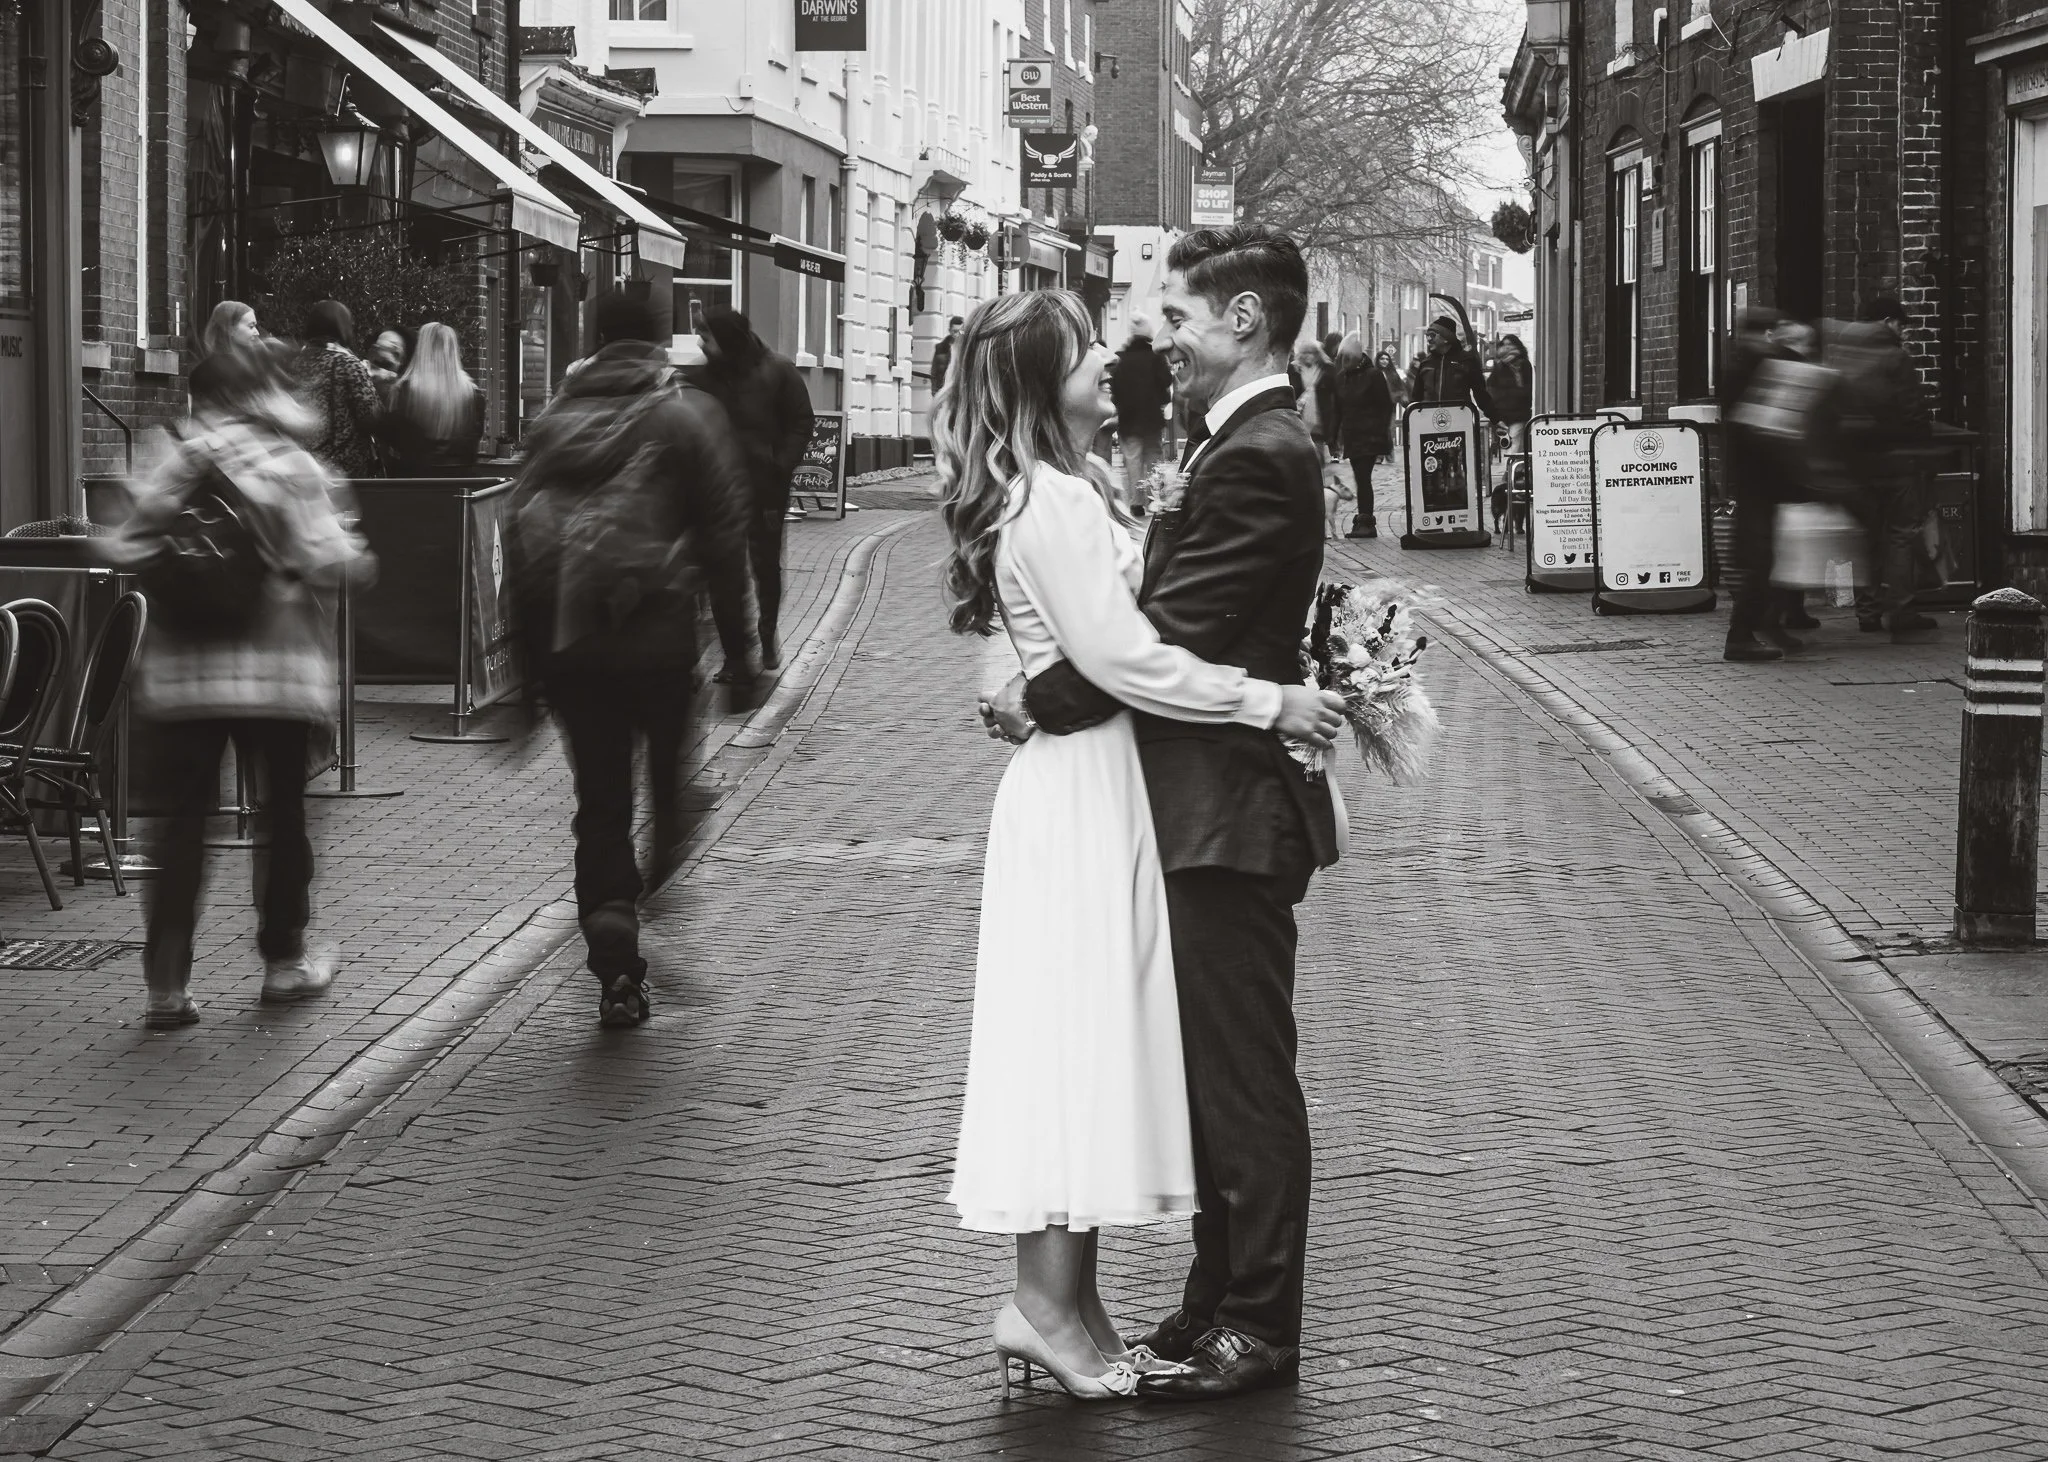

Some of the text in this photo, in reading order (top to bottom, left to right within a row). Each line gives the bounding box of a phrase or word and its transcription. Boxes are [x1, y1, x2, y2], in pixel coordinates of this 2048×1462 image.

[801, 0, 858, 15] DARWIN'S
[1022, 71, 1039, 80] BW
[1021, 94, 1041, 102] Best
[1012, 101, 1049, 110] Western
[1198, 189, 1228, 199] SHOP
[1196, 199, 1230, 209] TO LET
[1, 335, 22, 357] MUSIC
[1423, 436, 1462, 454] Round?
[1574, 450, 1590, 458] 4pm
[1621, 462, 1678, 472] UPCOMING
[1605, 475, 1694, 488] ENTERTAINMENT
